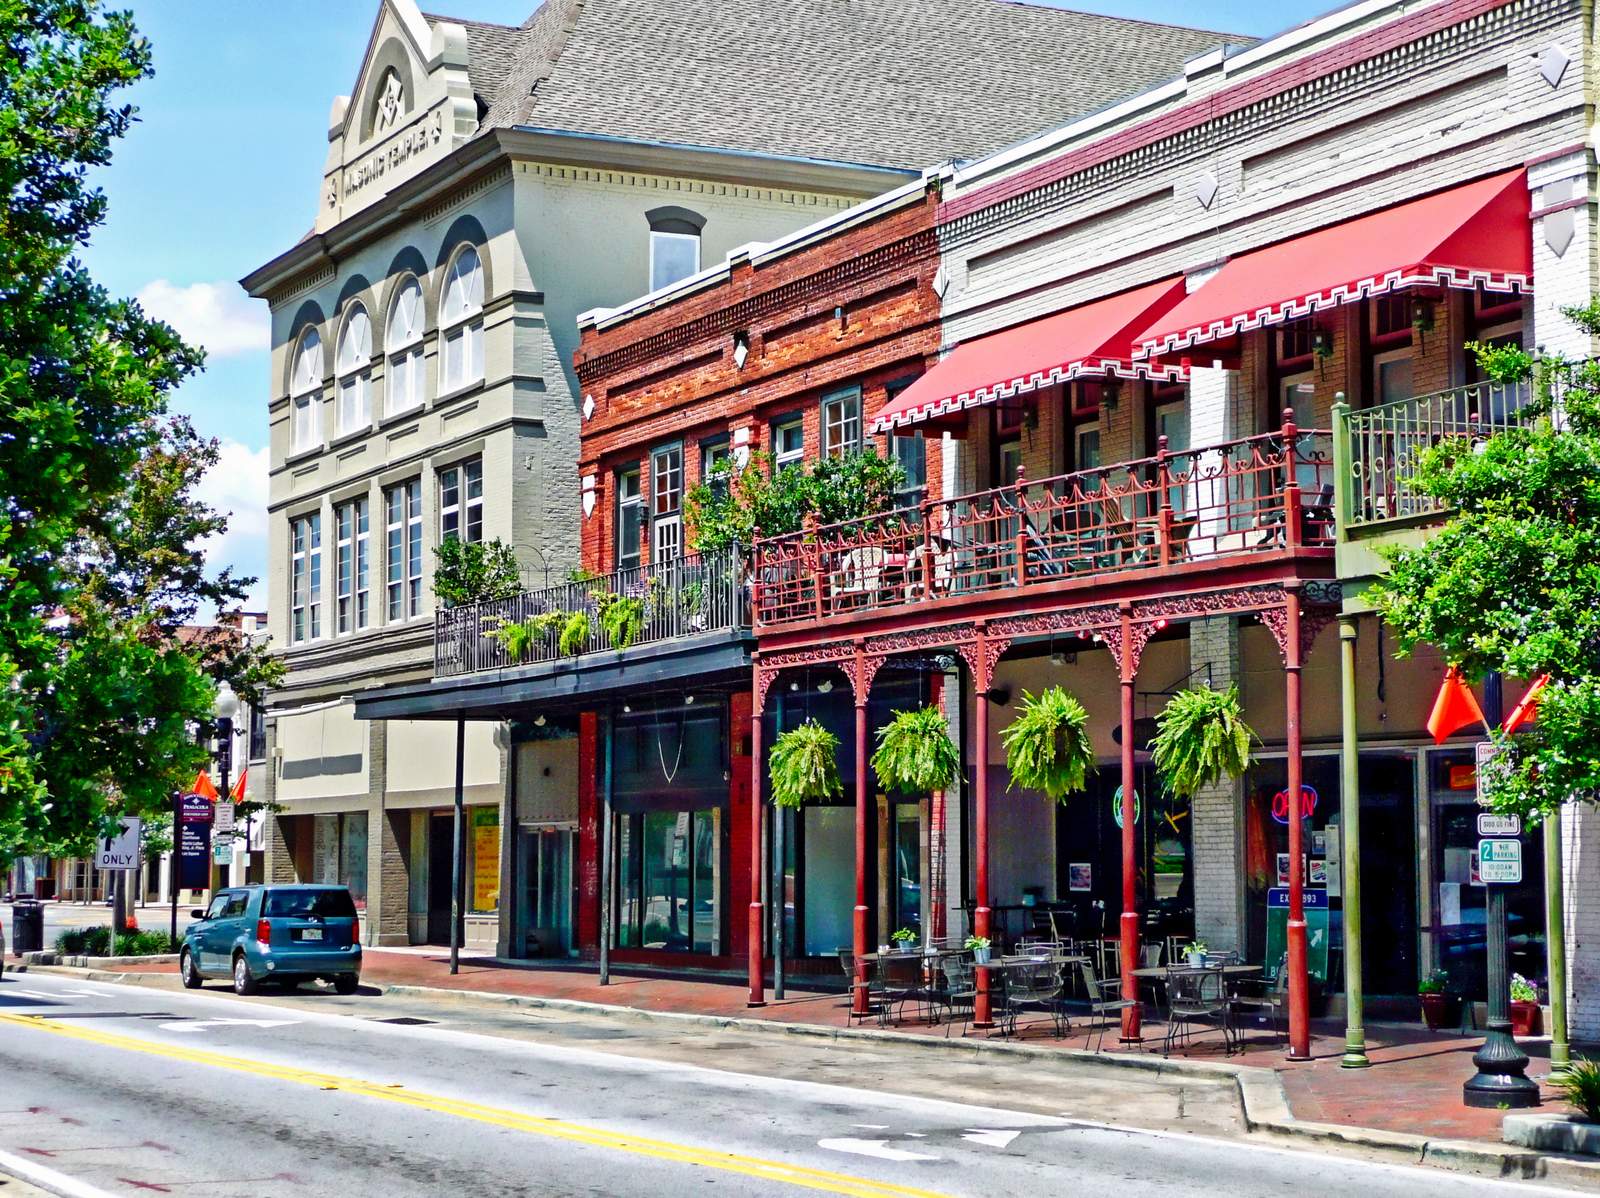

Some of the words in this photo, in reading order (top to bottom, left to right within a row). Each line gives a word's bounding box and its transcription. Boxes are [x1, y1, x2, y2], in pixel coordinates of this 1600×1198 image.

[387, 127, 429, 172] TEMPLE
[1271, 792, 1314, 816] OPN
[102, 854, 133, 865] ONLY
[1483, 843, 1491, 859] 2
